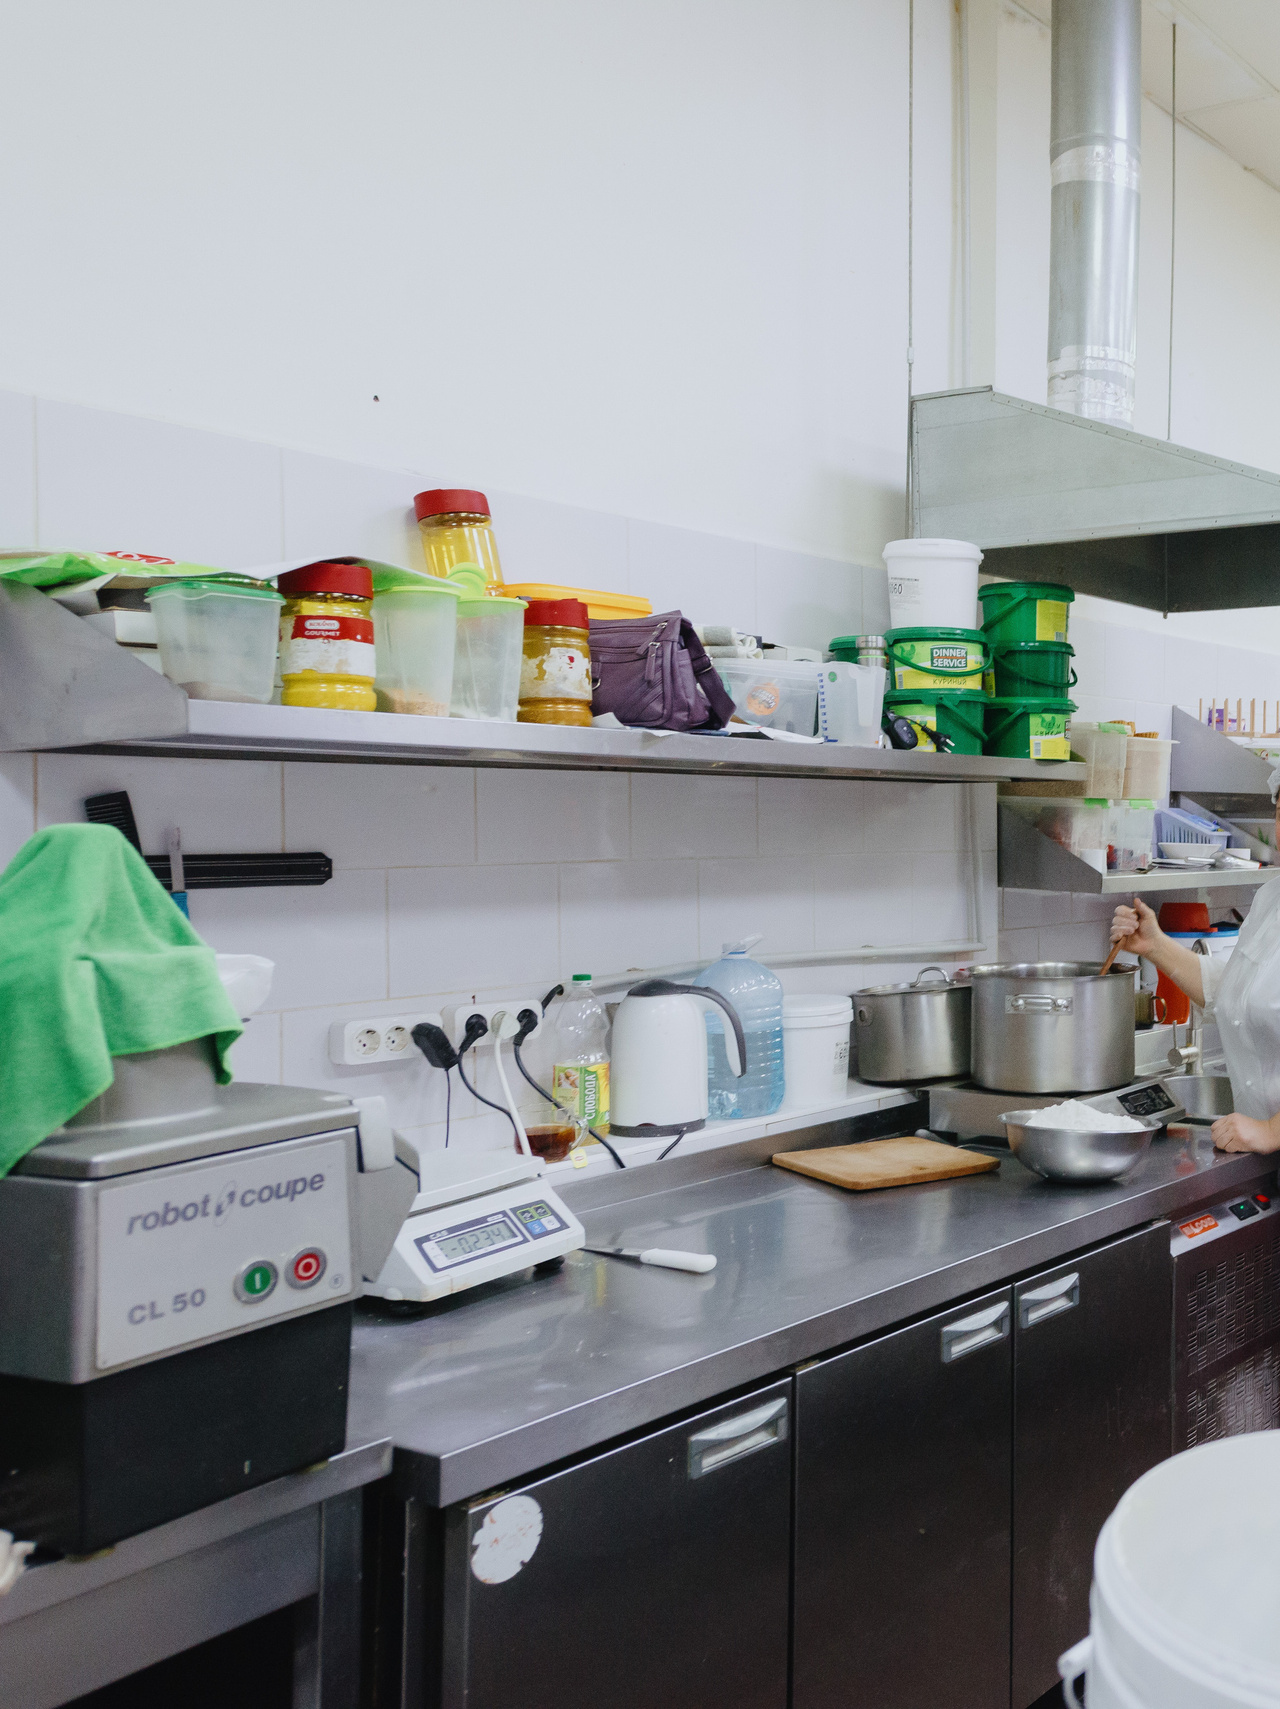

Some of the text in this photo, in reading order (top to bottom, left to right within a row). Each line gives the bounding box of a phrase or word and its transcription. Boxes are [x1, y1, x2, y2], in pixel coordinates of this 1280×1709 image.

[932, 648, 966, 657] DINNER
[932, 658, 966, 667] SERVICE
[584, 1073, 597, 1120] СЛОБОДА
[127, 1173, 325, 1236] robot coupe
[127, 1288, 206, 1326] CL 50
